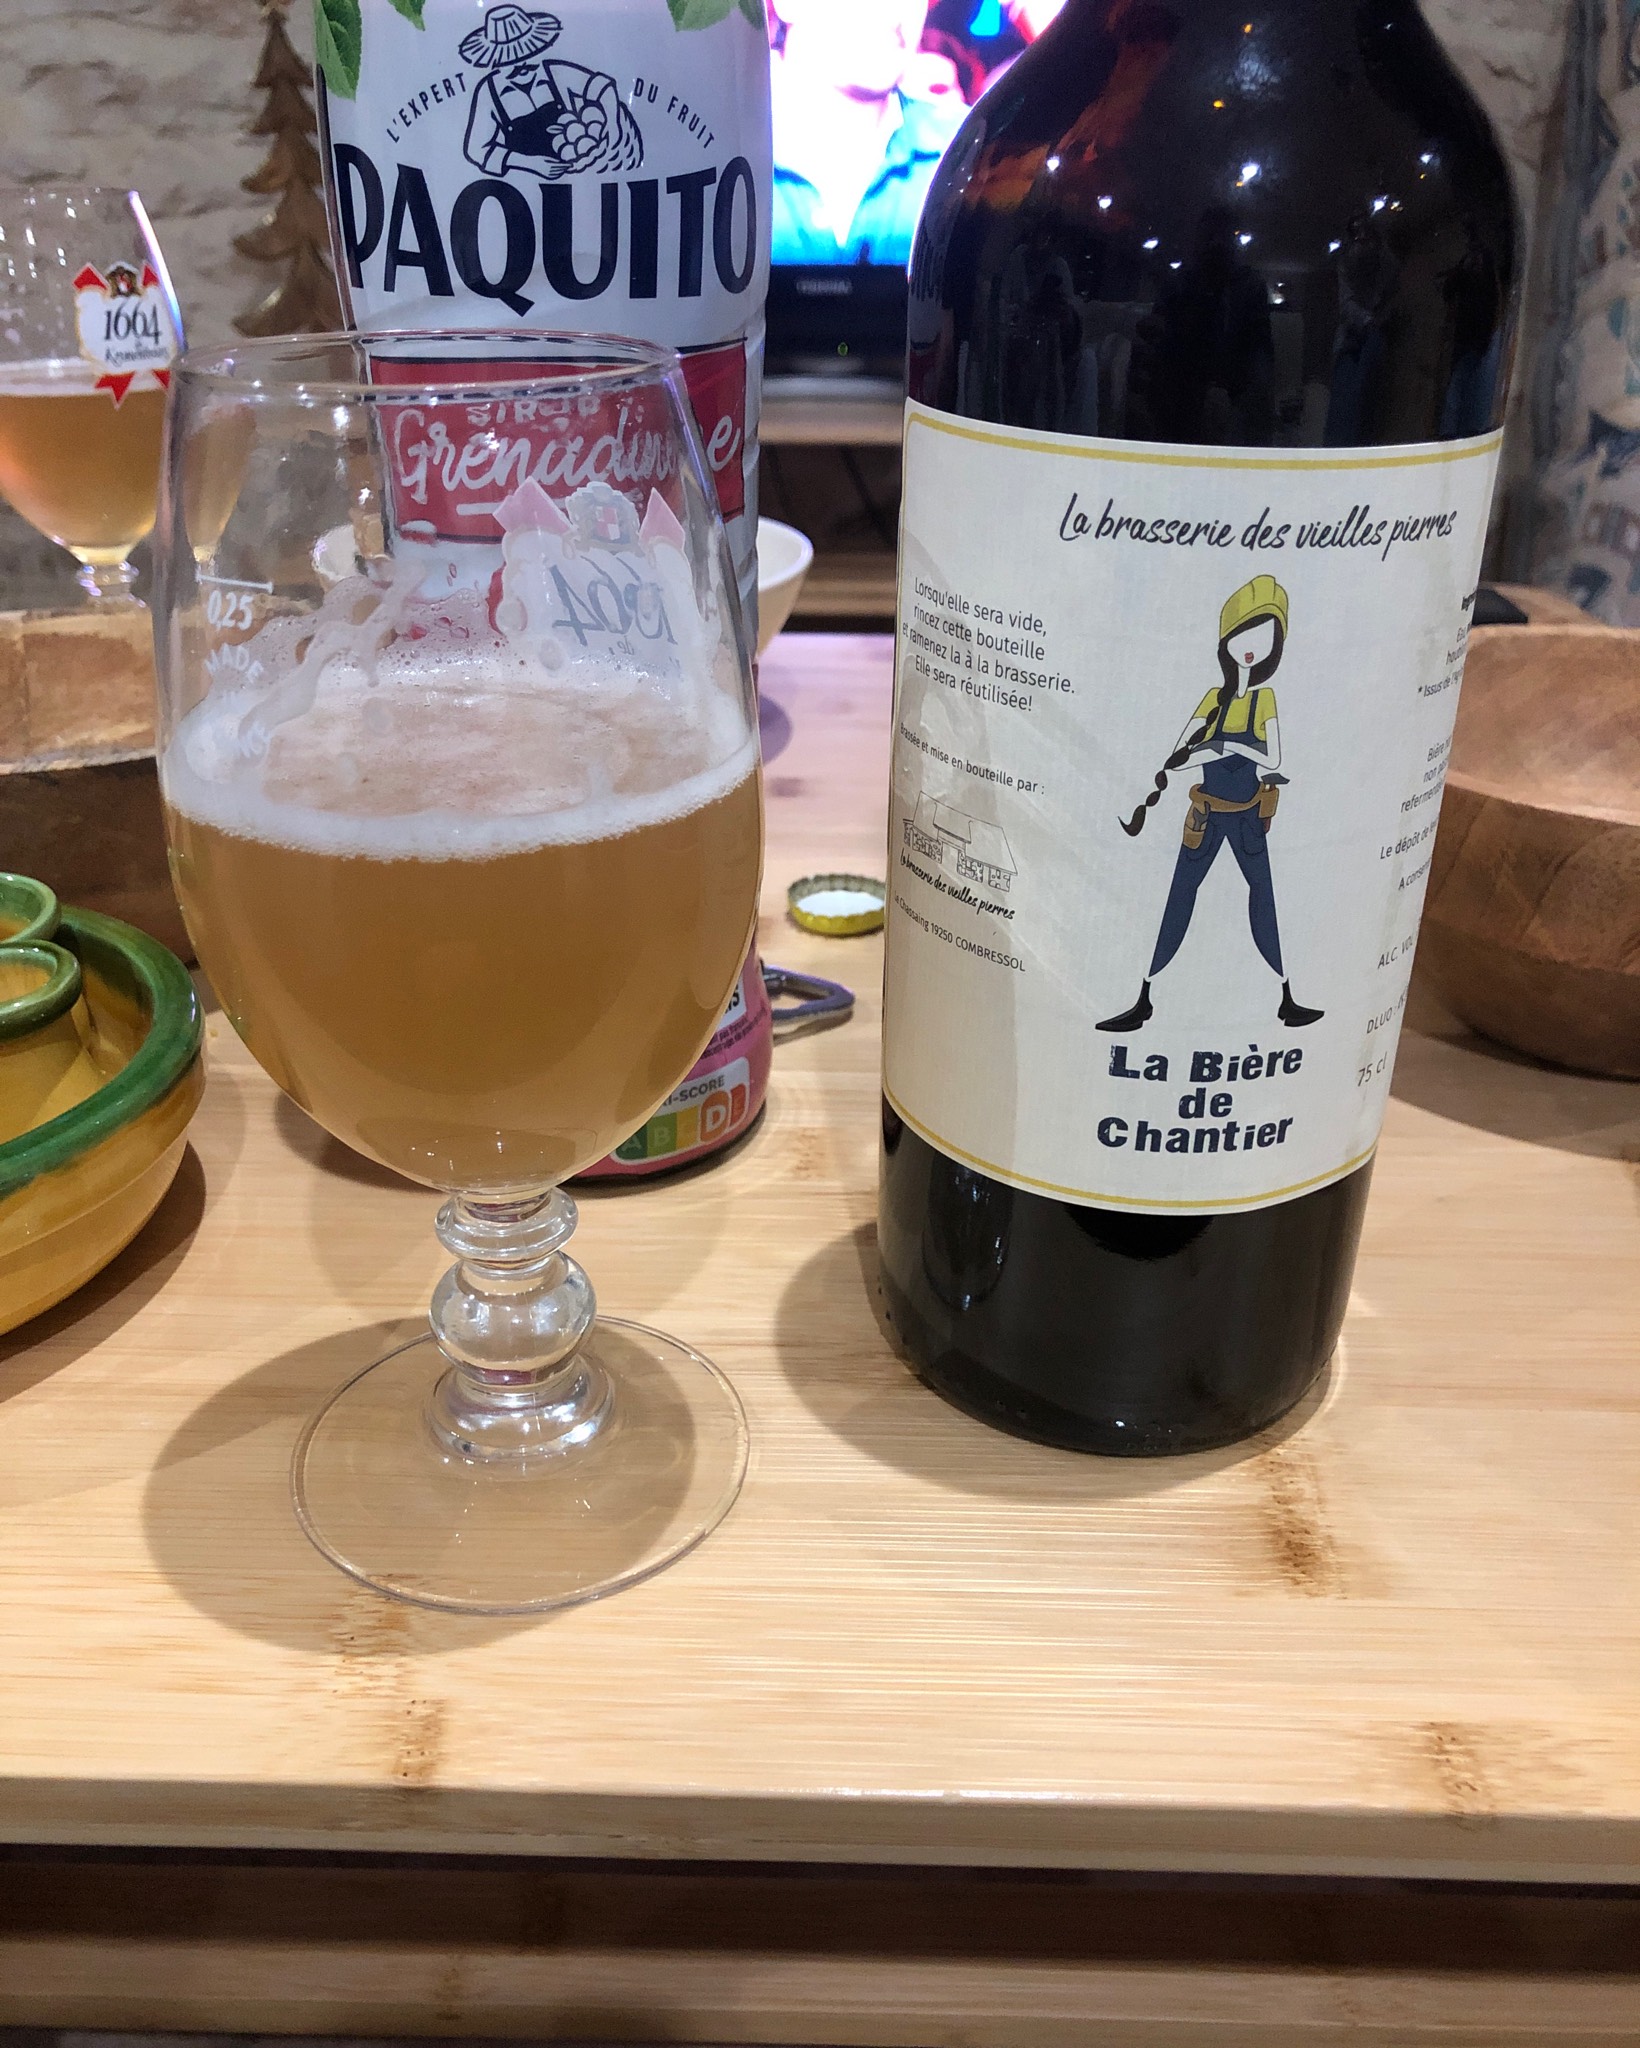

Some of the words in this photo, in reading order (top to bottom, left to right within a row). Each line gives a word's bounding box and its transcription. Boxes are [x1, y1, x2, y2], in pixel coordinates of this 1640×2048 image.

[386, 72, 468, 143] L'EXPERT
[633, 77, 659, 104] DU
[667, 98, 715, 150] FRUIT
[333, 143, 757, 317] PAQUITO
[104, 301, 162, 345] 1664
[1059, 492, 1092, 542] La
[1095, 498, 1236, 549] brasserie
[1240, 506, 1290, 552] des
[1295, 504, 1386, 550] vieilles
[1380, 510, 1458, 562] pierres
[913, 602, 940, 631] rincez
[942, 619, 972, 643] cette
[976, 627, 1046, 661] bouteille
[914, 577, 970, 615] Lorsqu'elle
[973, 603, 1004, 625] sera
[1008, 610, 1048, 638] vide,
[909, 628, 948, 660] ramenez
[949, 644, 961, 665] la
[964, 649, 973, 670] à
[977, 654, 990, 675] la
[994, 659, 1076, 694] brasserie.
[915, 654, 931, 677] Elle
[933, 668, 957, 690] sera
[960, 676, 1033, 712] réutilisée!
[921, 741, 929, 754] et
[930, 746, 950, 765] mise
[951, 756, 964, 772] en
[965, 759, 1014, 788] bouteille
[1017, 777, 1039, 794] par
[1380, 846, 1393, 860] Le
[1395, 831, 1421, 853] dépôt
[934, 873, 947, 894] des
[948, 882, 979, 909] vieilles
[977, 899, 1016, 921] pierres
[1398, 877, 1406, 892] A
[930, 922, 954, 944] 19250
[955, 936, 1026, 973] COMBRESSOL
[1108, 1044, 1169, 1082] La
[1189, 1043, 1304, 1083] Bière
[1357, 1062, 1374, 1088] 75
[1376, 1051, 1388, 1074] cl
[705, 1104, 728, 1133] D
[1178, 1087, 1233, 1120] de
[1097, 1116, 1294, 1154] Chantier
